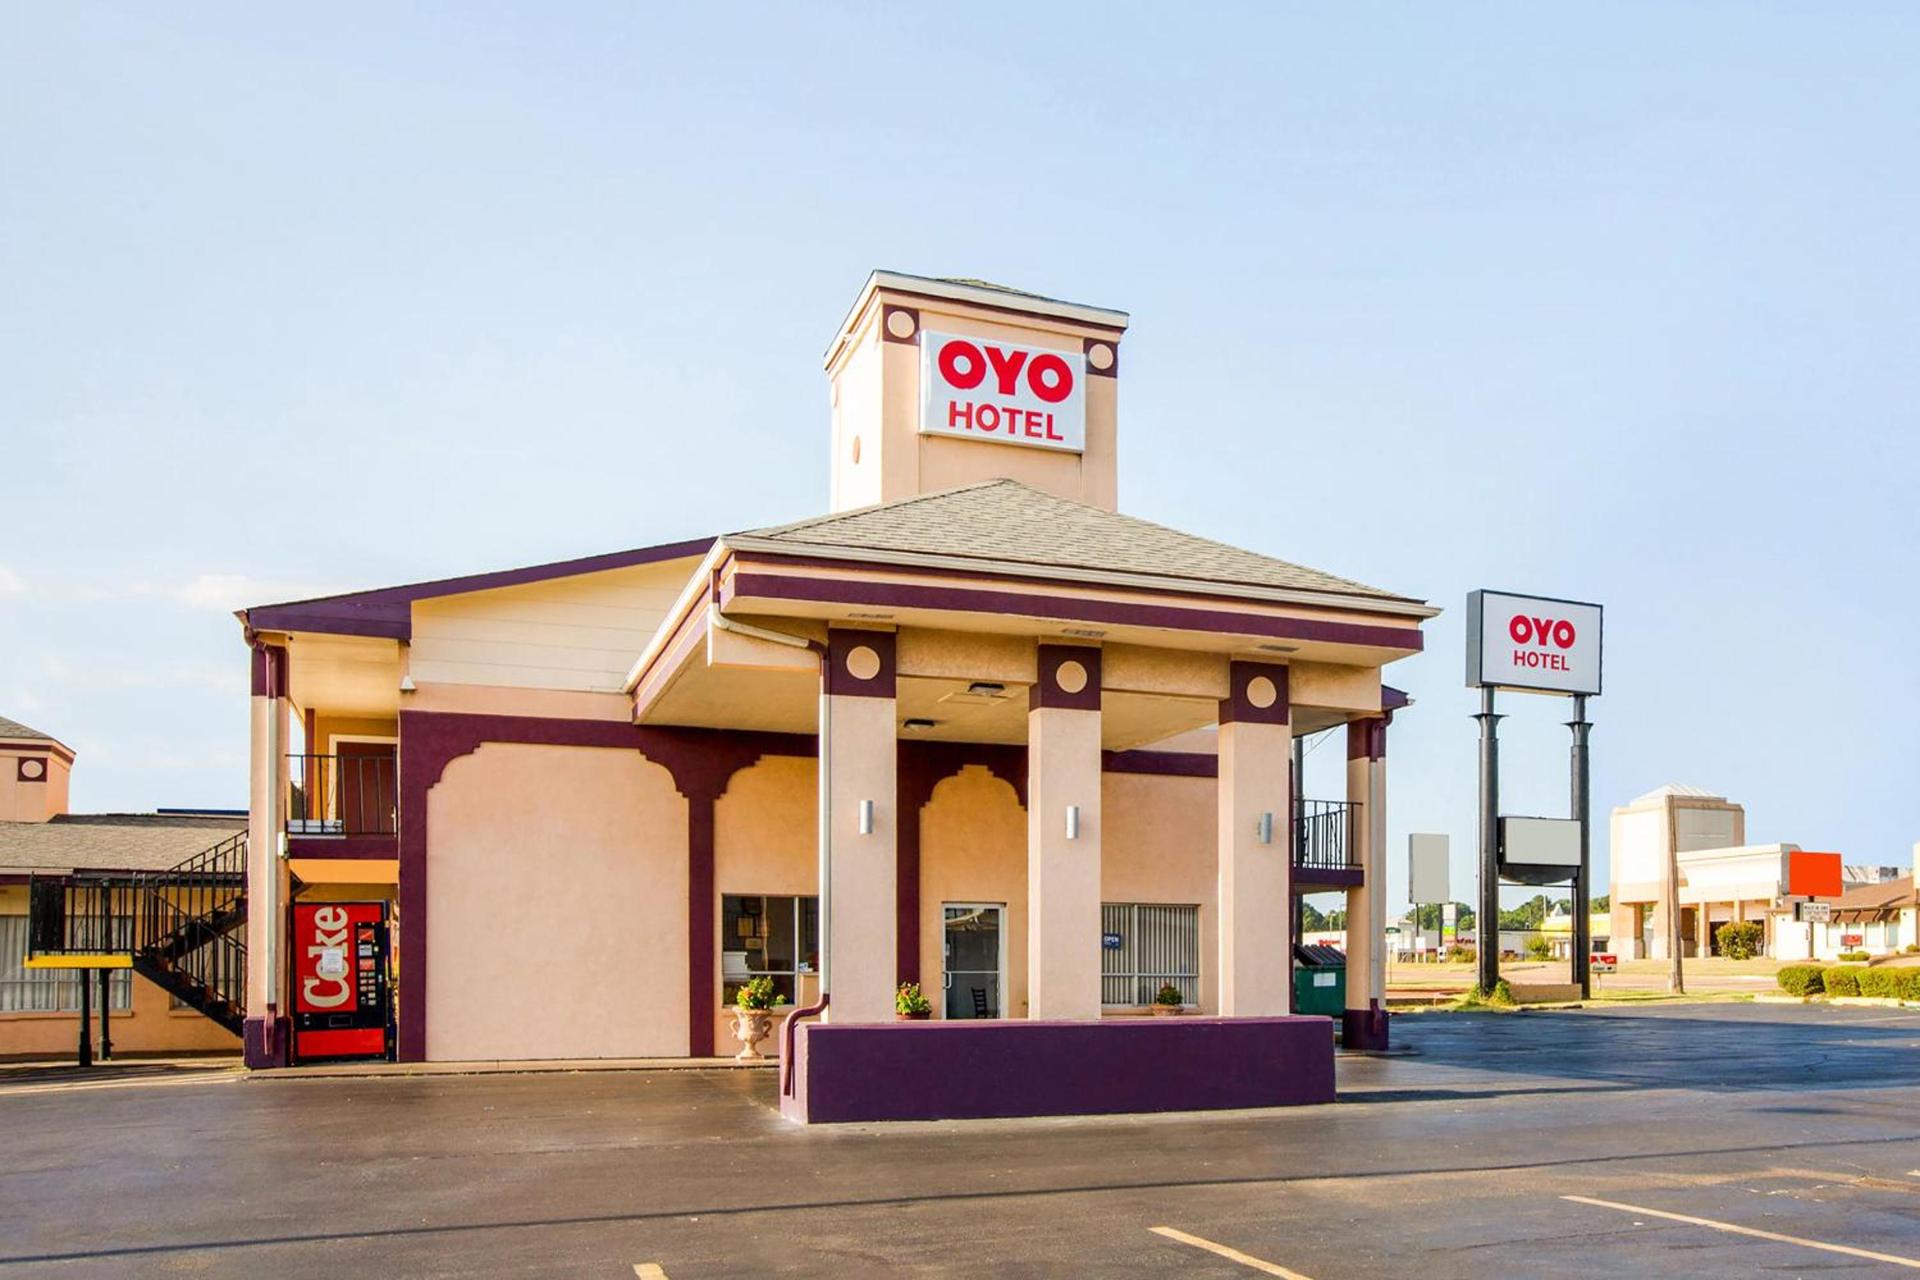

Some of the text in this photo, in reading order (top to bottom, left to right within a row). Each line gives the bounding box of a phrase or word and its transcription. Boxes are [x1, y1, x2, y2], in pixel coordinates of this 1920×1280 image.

[938, 340, 1073, 403] OYO
[949, 401, 1063, 441] HOTEL
[1509, 614, 1576, 649] OYO
[1514, 649, 1570, 671] HOTEL
